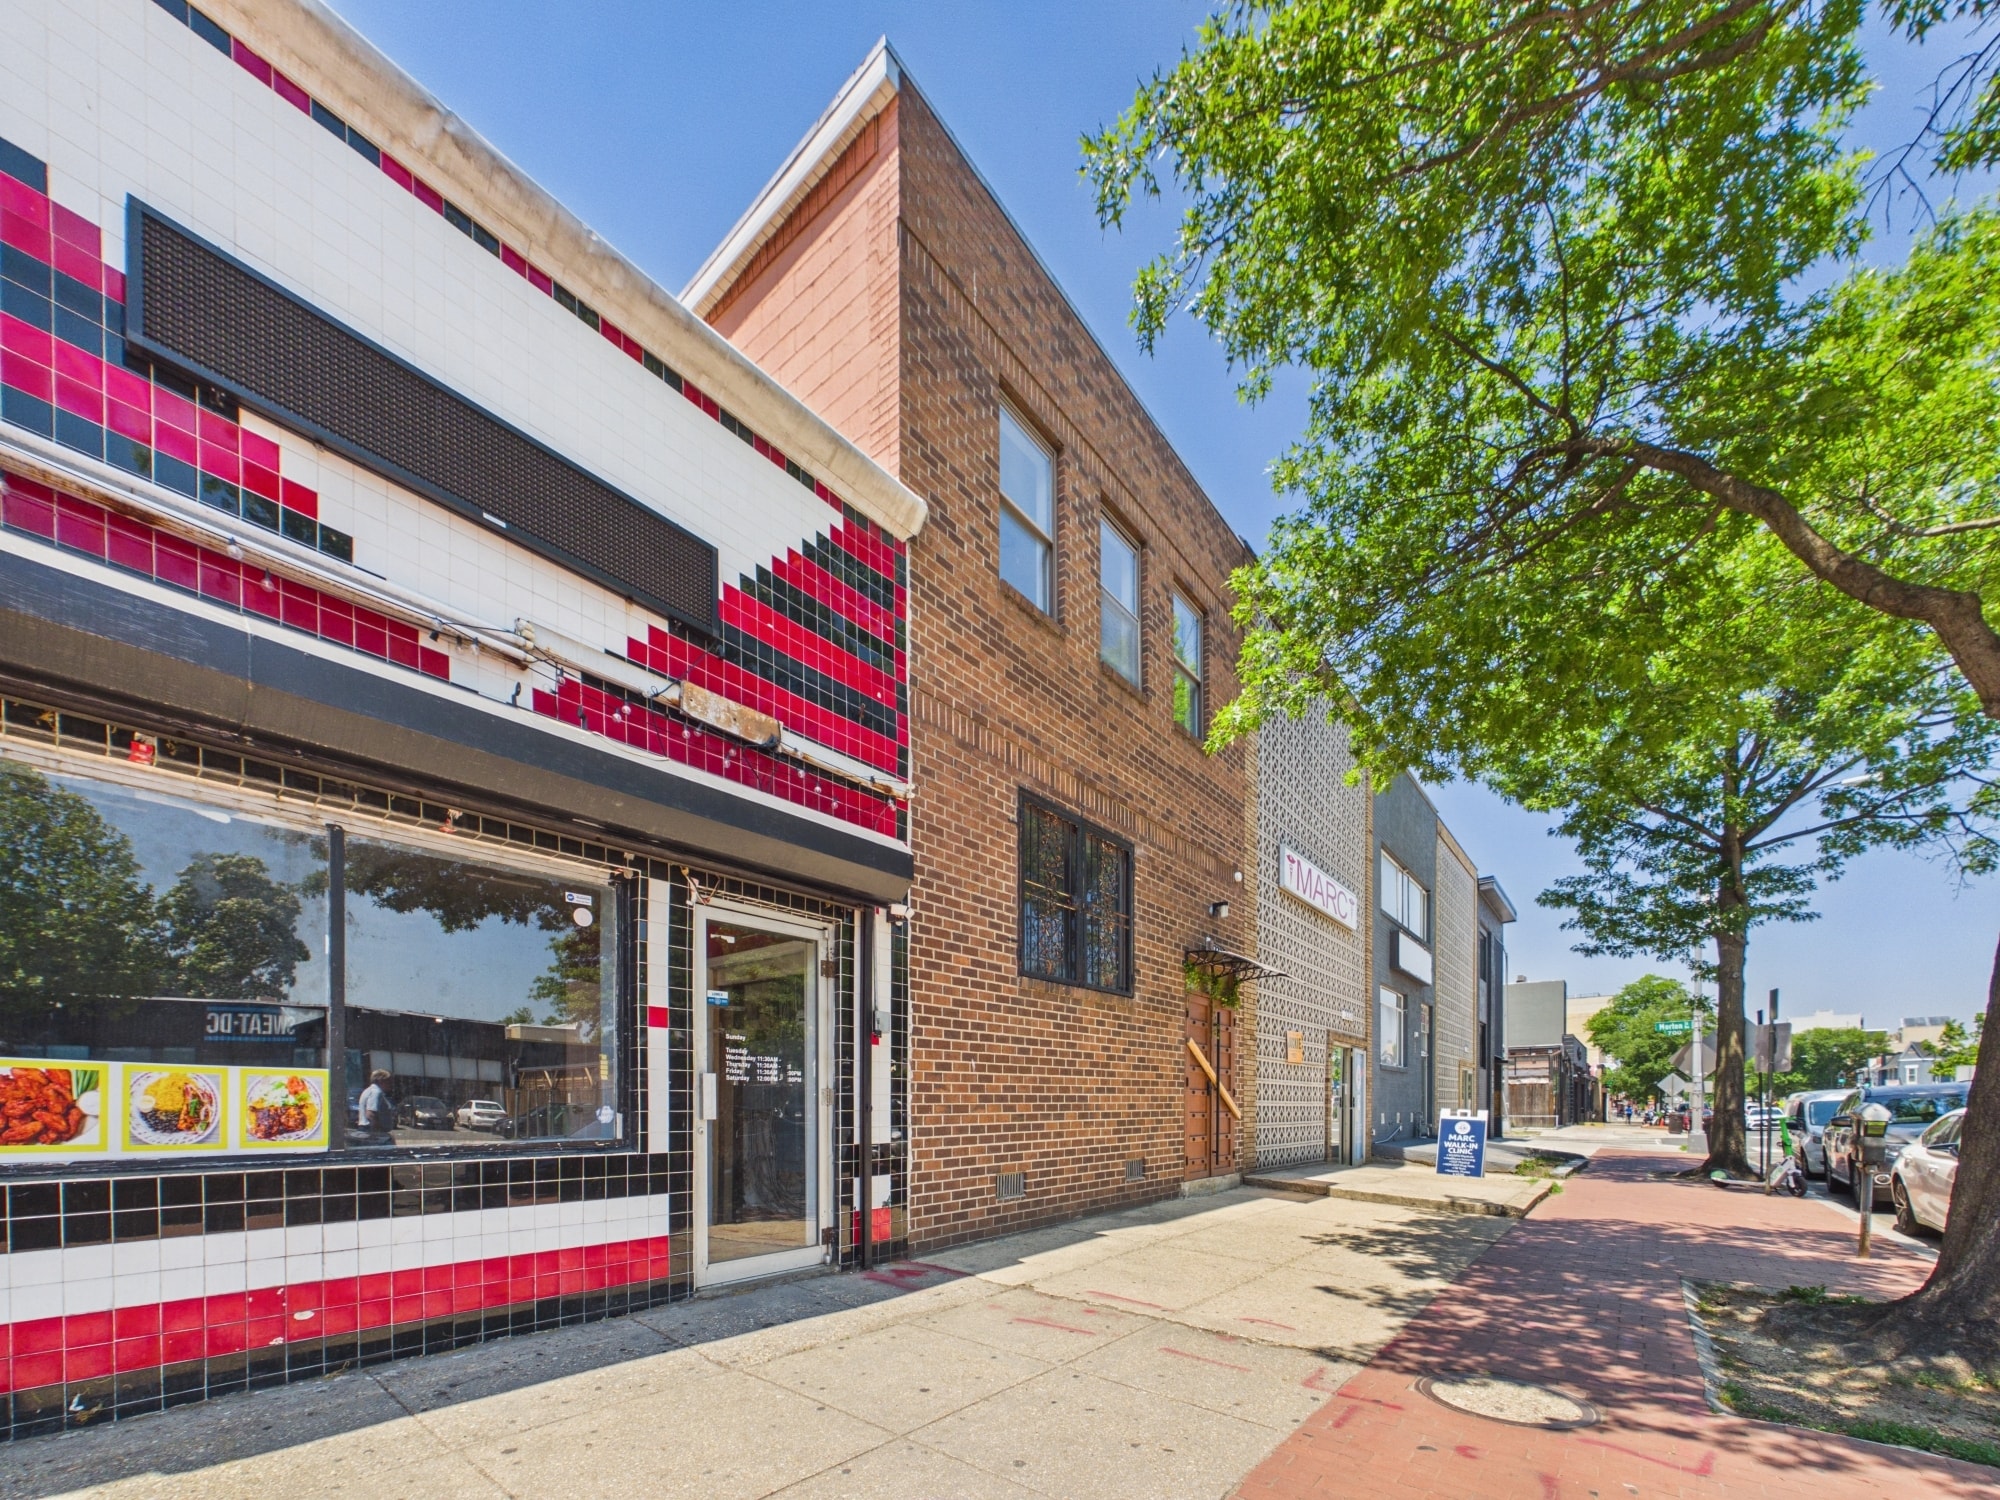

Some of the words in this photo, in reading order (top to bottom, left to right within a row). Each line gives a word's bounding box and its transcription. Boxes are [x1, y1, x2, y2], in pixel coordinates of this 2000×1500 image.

[1296, 859, 1348, 919] MARC
[725, 1033, 746, 1041] Sunday
[725, 1047, 748, 1056] Tuesday
[725, 1054, 756, 1062] Wednesday
[725, 1060, 751, 1069] Thursday
[725, 1067, 743, 1076] Friday
[725, 1074, 750, 1082] Saturday
[1448, 1134, 1475, 1142] MARC
[1443, 1141, 1478, 1149] WALK-IN
